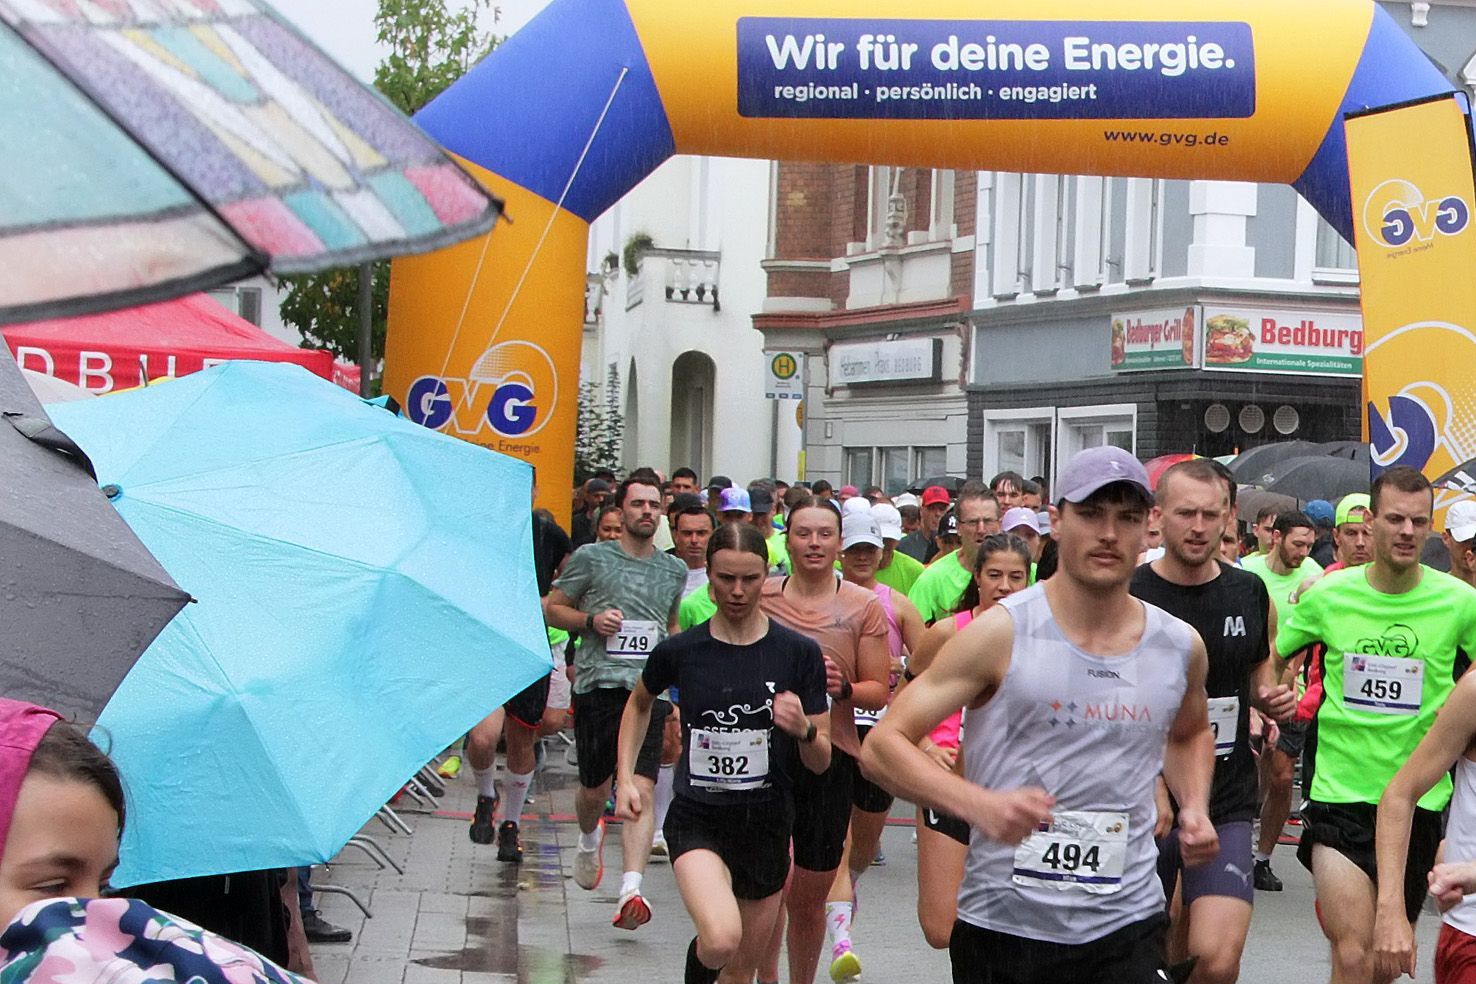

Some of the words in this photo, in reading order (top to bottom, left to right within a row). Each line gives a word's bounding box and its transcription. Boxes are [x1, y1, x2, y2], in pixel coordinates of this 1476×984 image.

[765, 34, 844, 71] Wir
[856, 34, 918, 71] für
[931, 36, 1050, 71] deine
[1064, 36, 1236, 76] Energie.
[774, 81, 858, 101] regional
[876, 83, 982, 103] persönlich
[999, 83, 1097, 104] engagiert
[1103, 128, 1230, 147] www.gvg.de
[1256, 357, 1306, 368] Internationale
[1307, 359, 1353, 370] Spezialitäten
[406, 360, 549, 438] GVG
[498, 439, 541, 457] Energie
[617, 635, 649, 651] 749
[1087, 668, 1121, 679] FUSION
[1360, 678, 1402, 700] 459
[708, 755, 750, 776] 382
[1042, 842, 1100, 873] 494
